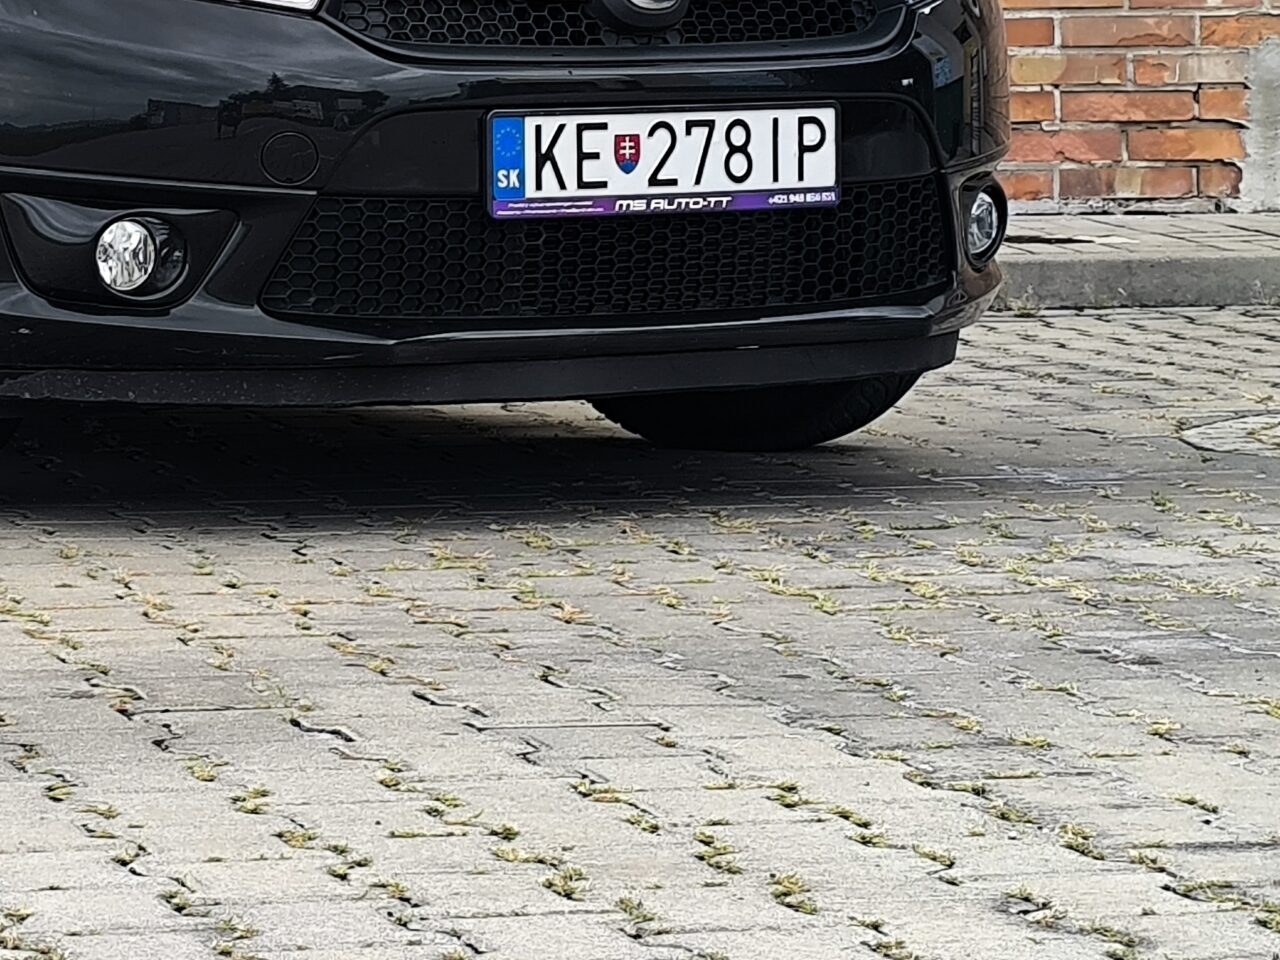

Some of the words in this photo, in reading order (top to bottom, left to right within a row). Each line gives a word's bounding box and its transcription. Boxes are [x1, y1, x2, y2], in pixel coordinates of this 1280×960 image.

[534, 121, 609, 191] KE
[646, 115, 827, 187] 278IP
[497, 169, 520, 189] SK
[615, 199, 647, 211] MS
[650, 196, 732, 210] AUTO-TT
